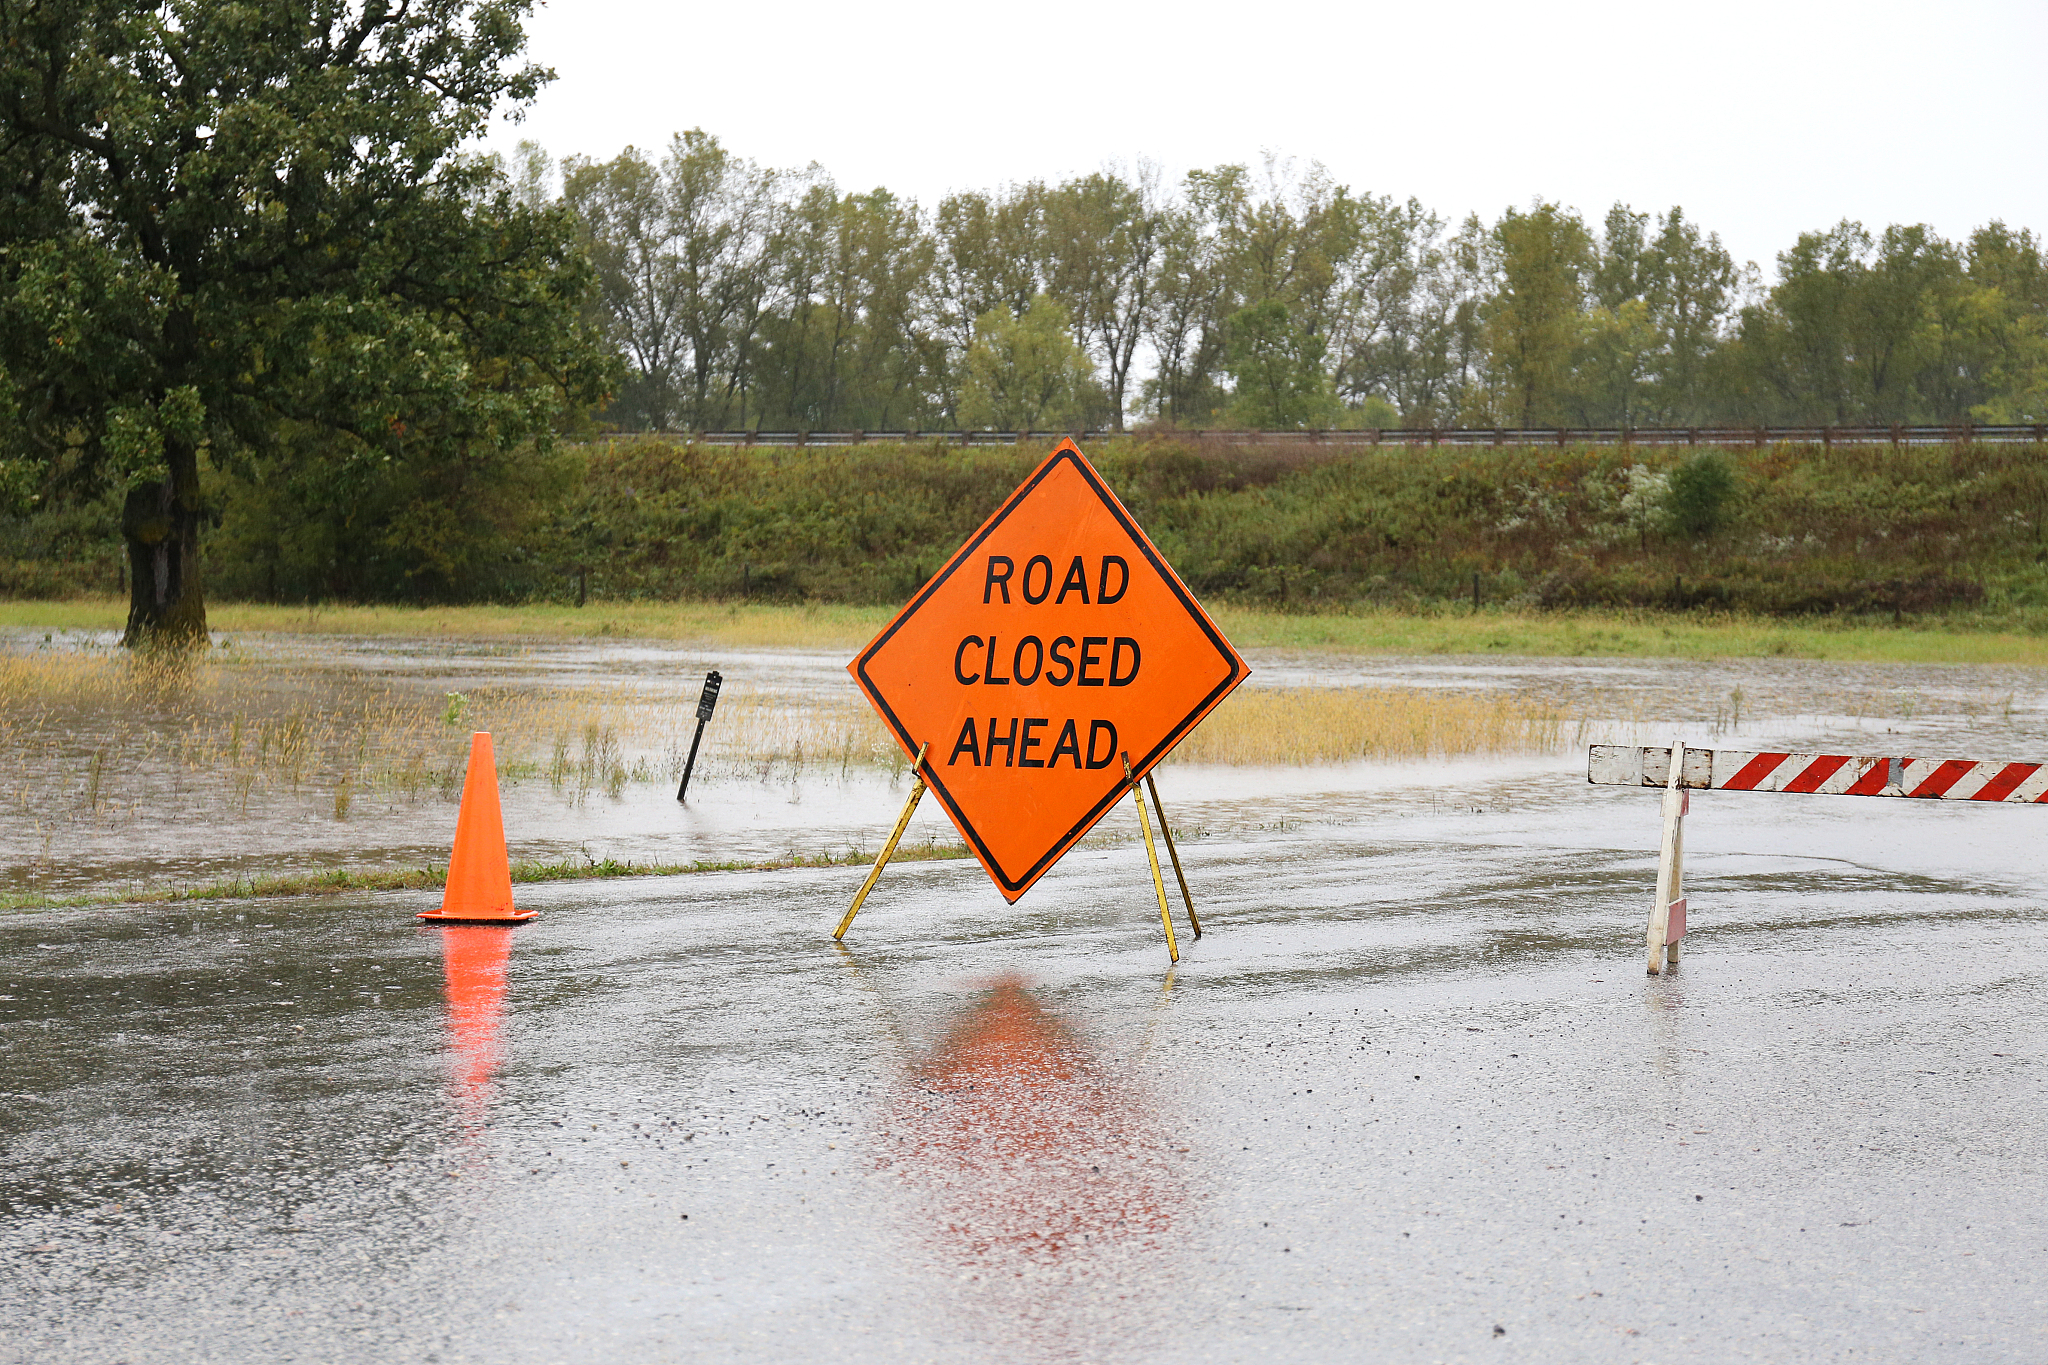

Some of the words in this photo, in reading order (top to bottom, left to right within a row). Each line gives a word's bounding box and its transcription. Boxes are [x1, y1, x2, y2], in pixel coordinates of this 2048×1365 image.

[983, 555, 1129, 605] ROAD
[954, 635, 1141, 687] CLOSED
[947, 717, 1118, 770] AHEAD
